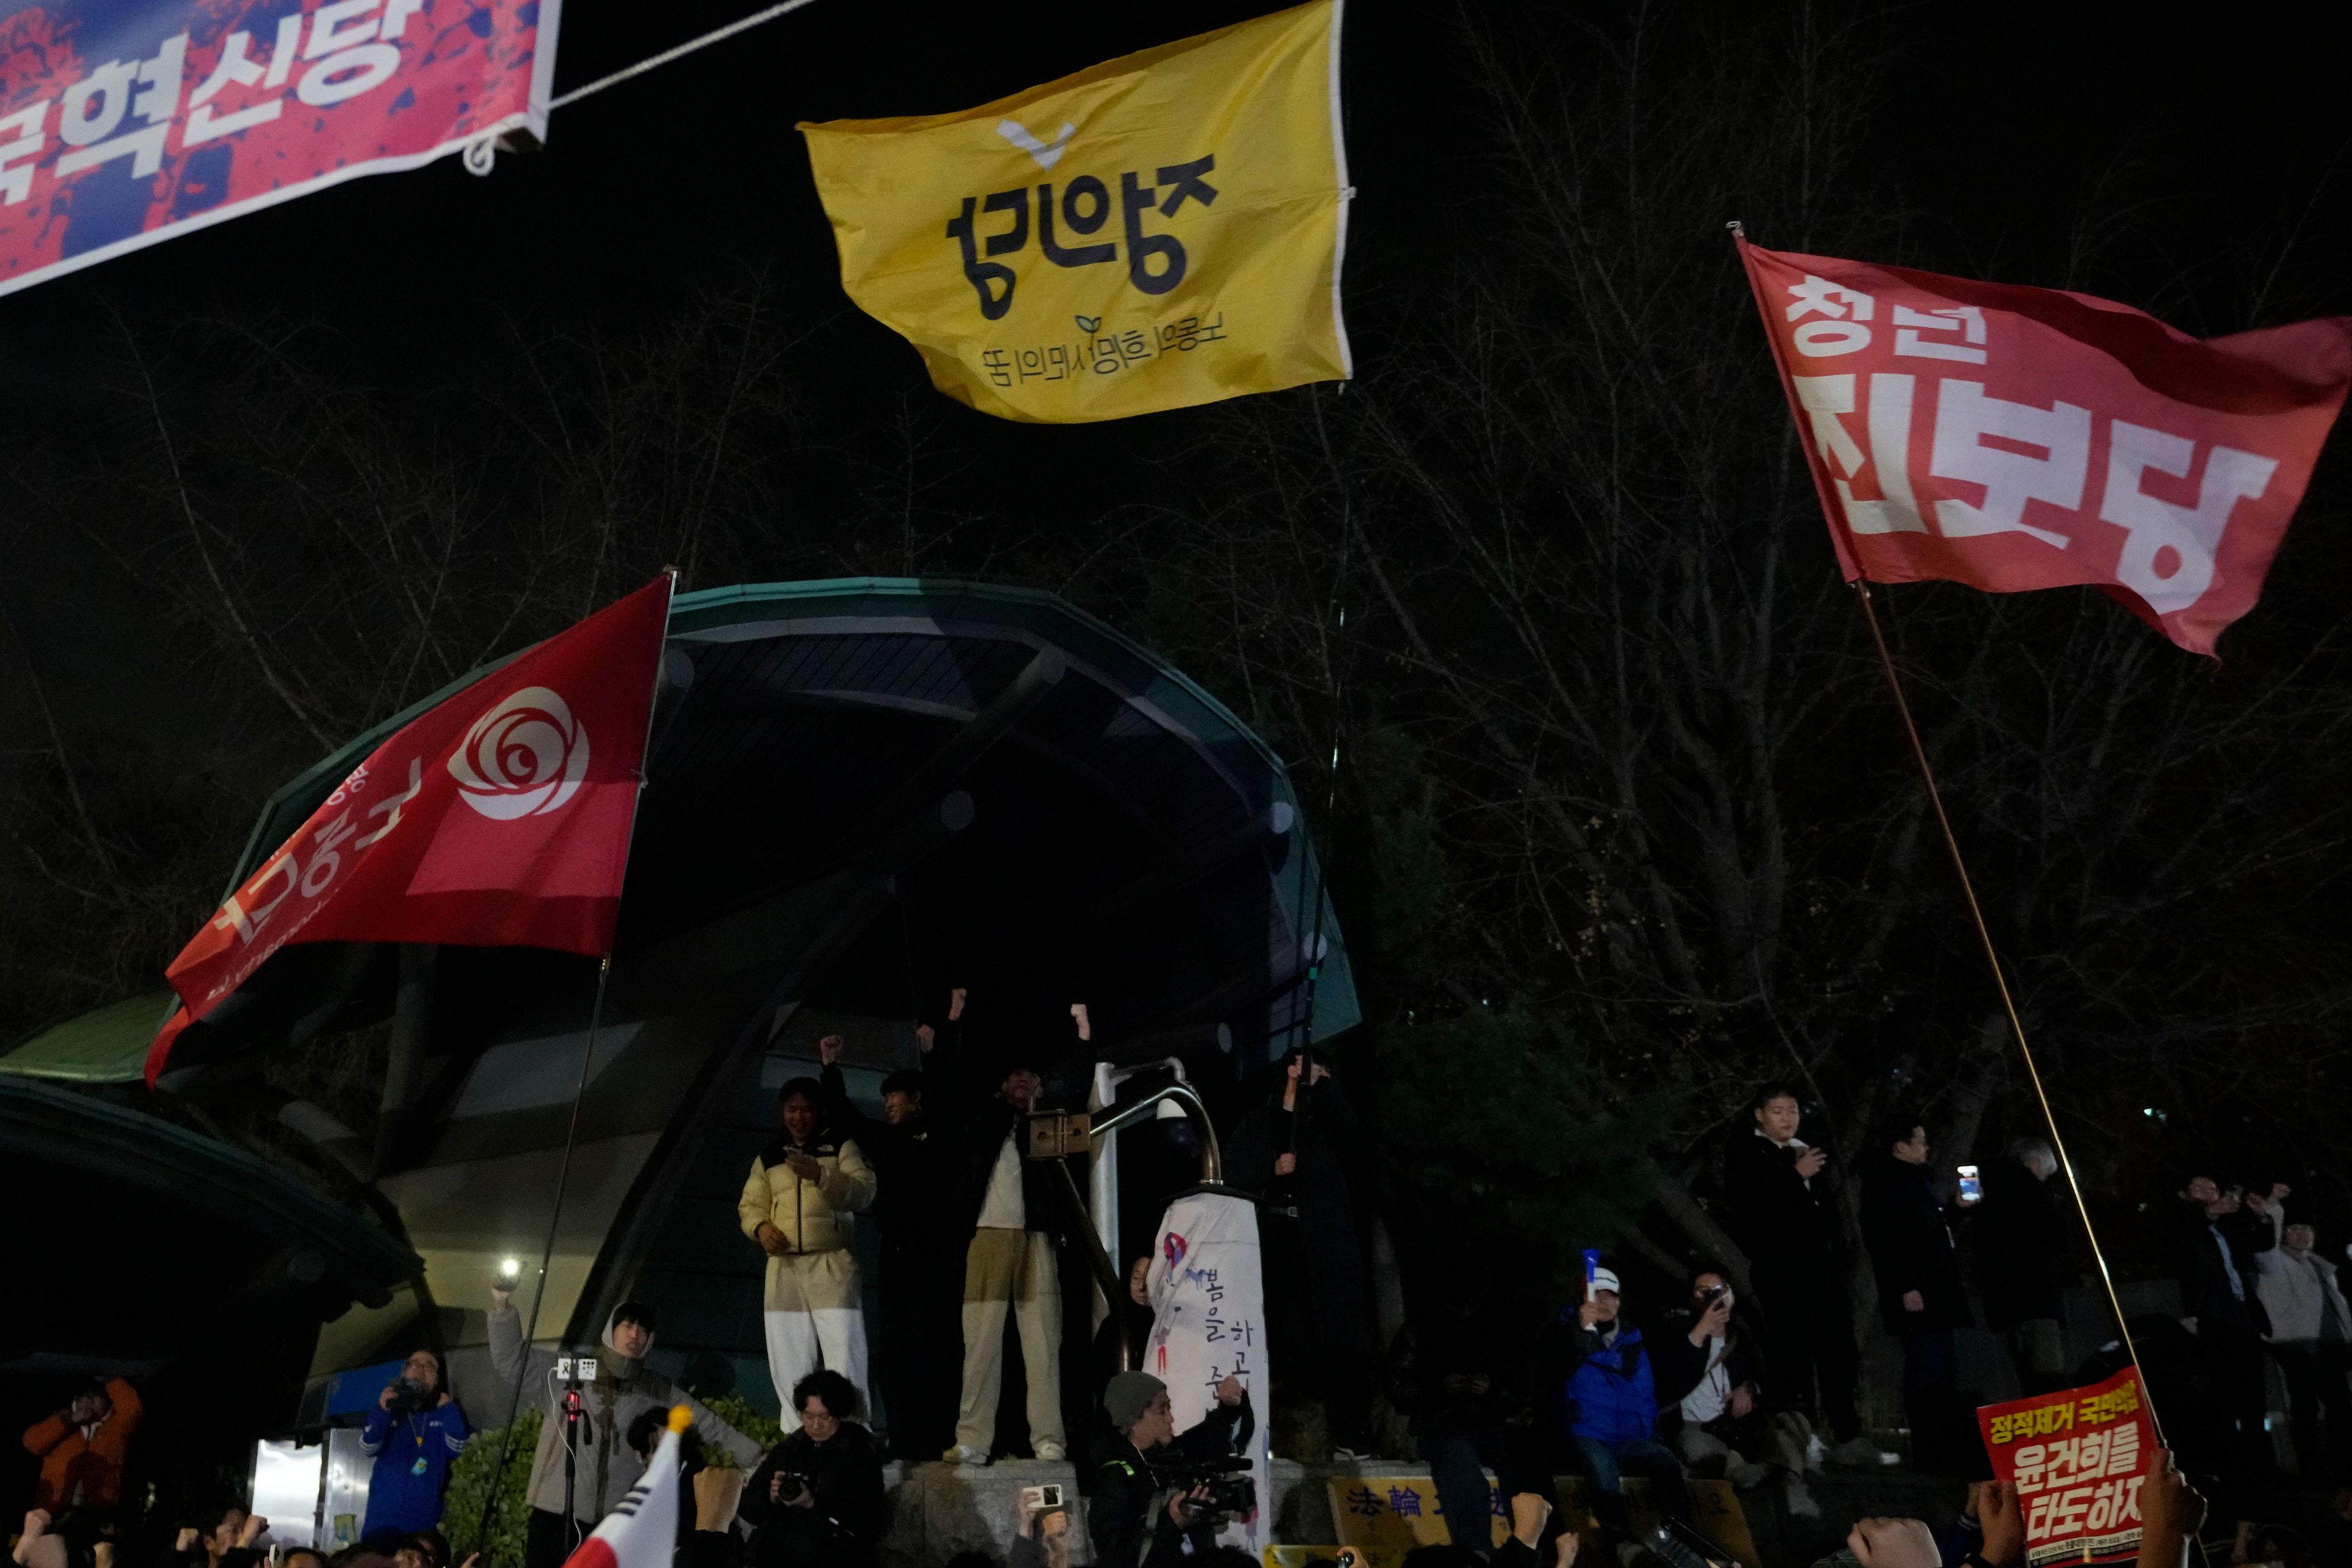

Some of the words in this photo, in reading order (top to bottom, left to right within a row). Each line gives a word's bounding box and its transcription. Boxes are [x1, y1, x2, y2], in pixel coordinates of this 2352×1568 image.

[1785, 274, 1988, 365] 청년
[1792, 371, 2280, 615] 진보당
[1205, 1268, 1226, 1343] 봄을
[1989, 1401, 2075, 1445] 정적제거
[2013, 1420, 2139, 1495] 윤건희를
[1346, 1485, 1507, 1518] 法輪
[2027, 1474, 2146, 1542] 타도하자
